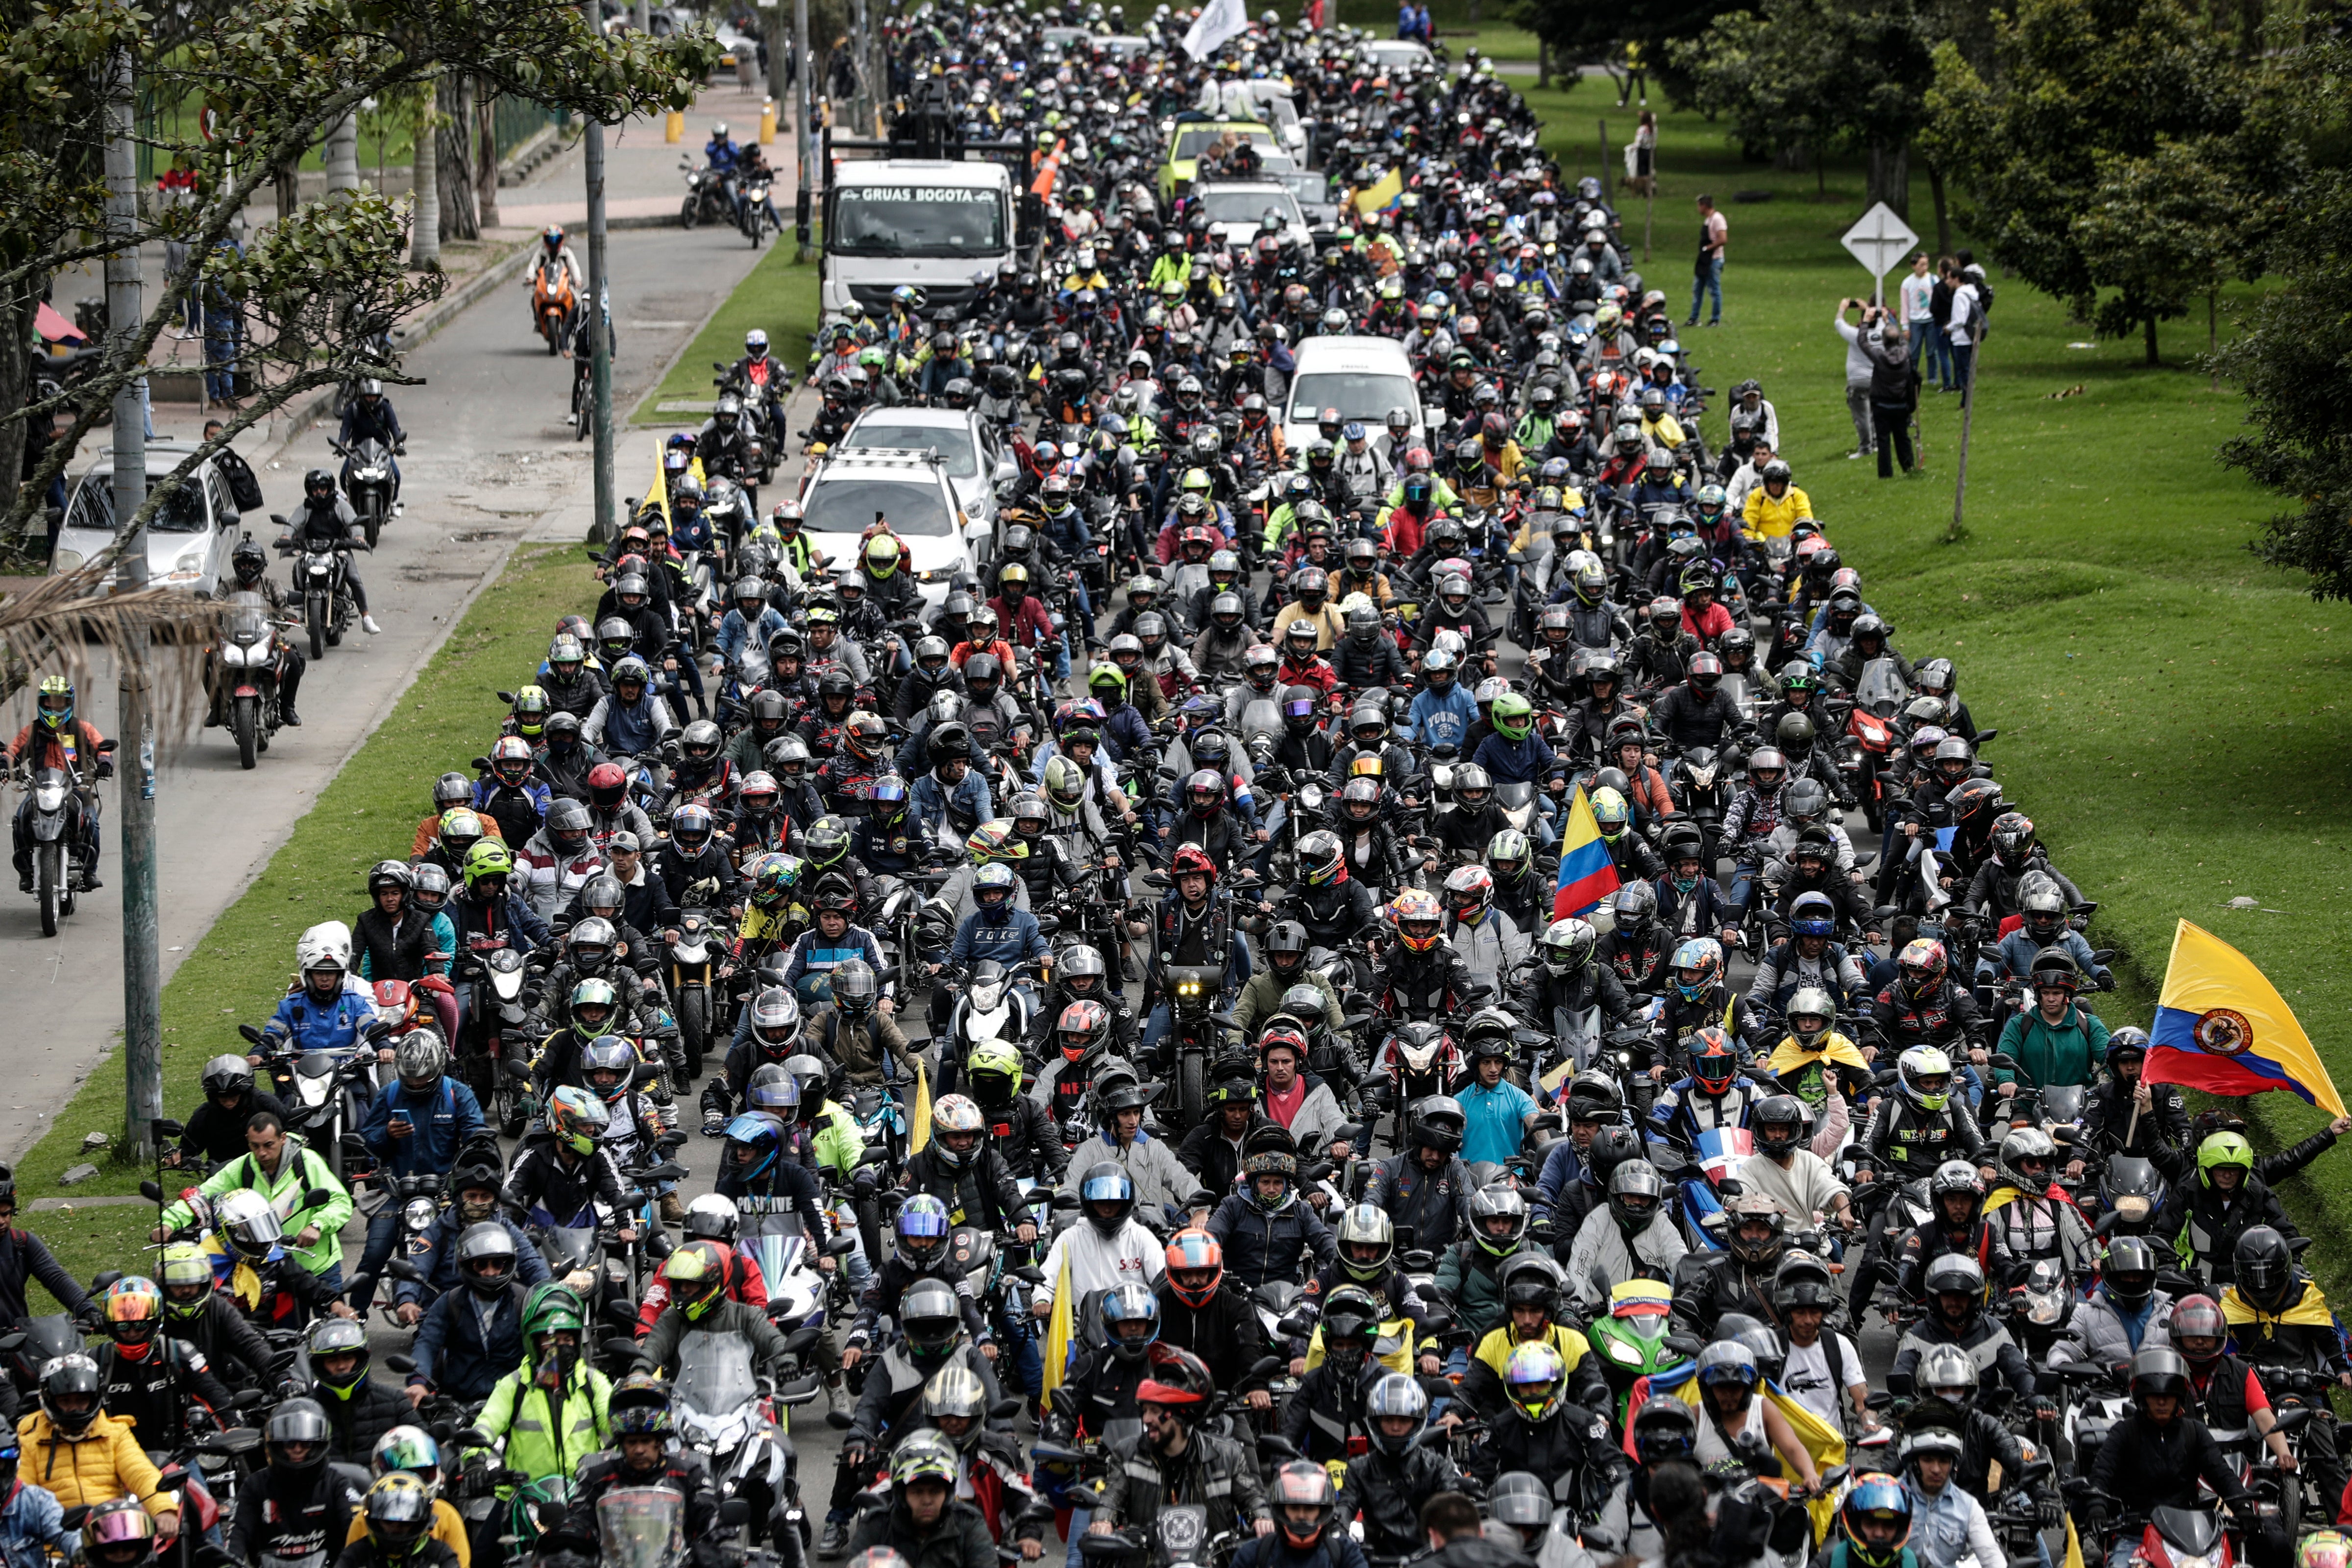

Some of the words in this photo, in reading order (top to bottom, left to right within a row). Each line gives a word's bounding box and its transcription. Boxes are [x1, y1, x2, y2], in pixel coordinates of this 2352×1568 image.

[862, 188, 911, 201] GRUAS
[916, 188, 973, 202] BOGOTA
[1428, 711, 1461, 727] YOUNG
[2212, 1010, 2252, 1044] REPUBLICA
[269, 1528, 327, 1547] Apache
